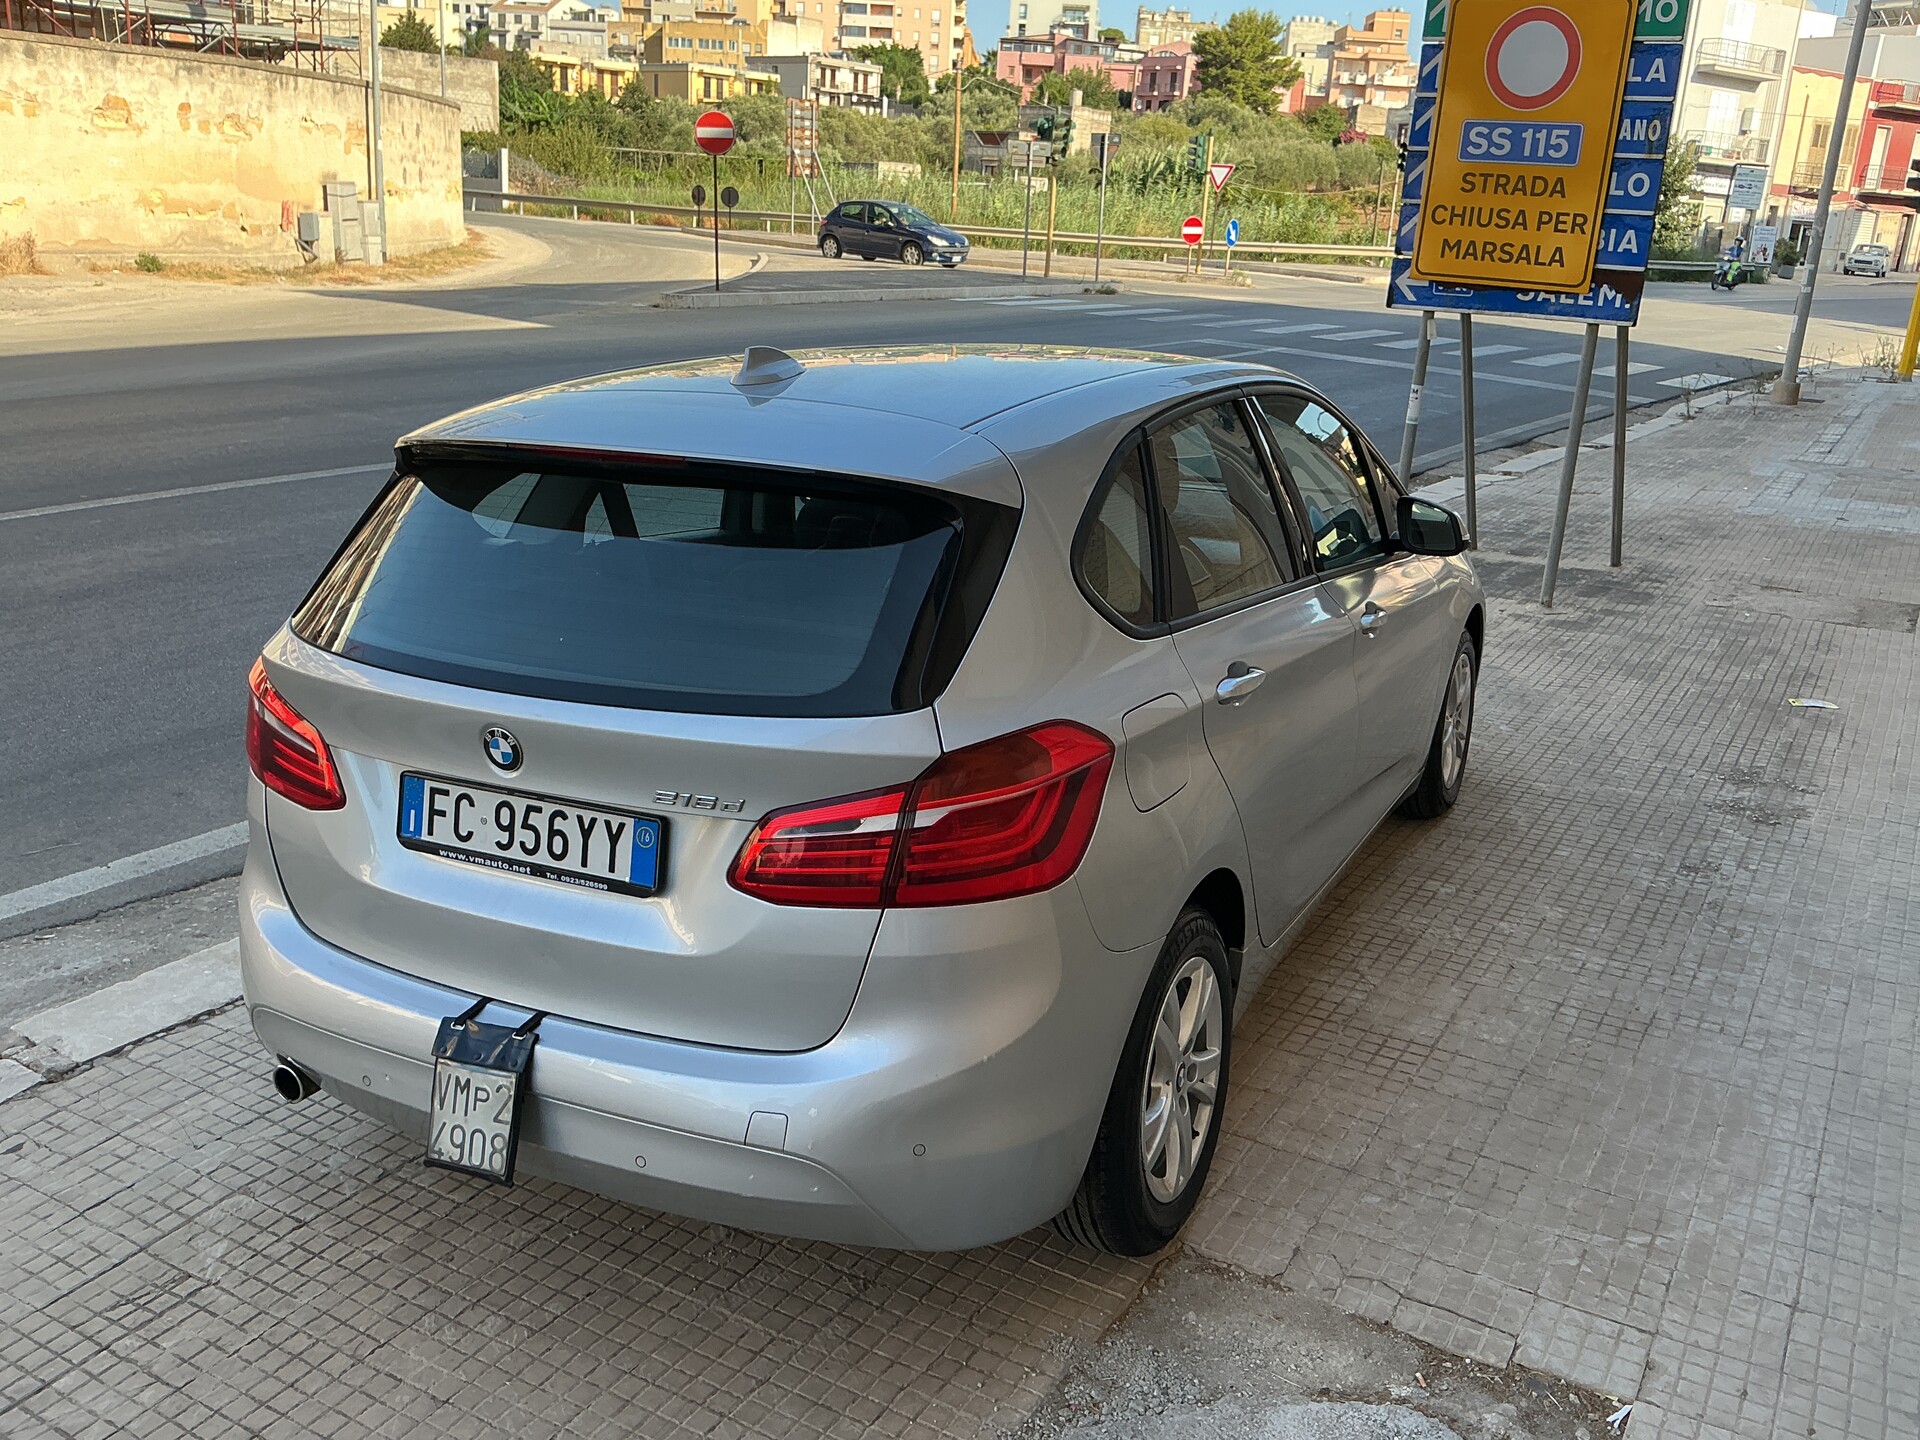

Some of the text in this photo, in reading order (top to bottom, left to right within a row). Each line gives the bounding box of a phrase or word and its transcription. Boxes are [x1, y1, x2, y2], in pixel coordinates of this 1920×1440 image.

[1466, 126, 1571, 158] SS 115
[1619, 119, 1661, 141] ANO
[1460, 172, 1566, 198] STRADA
[1431, 204, 1588, 235] CHIUSA PER
[1440, 238, 1565, 268] MARSALA
[485, 729, 516, 746] BMW
[427, 786, 626, 874] FC 956YY
[439, 849, 531, 874] www.vmauto.net
[545, 872, 559, 881] Tel.
[431, 1121, 508, 1174] 4908
